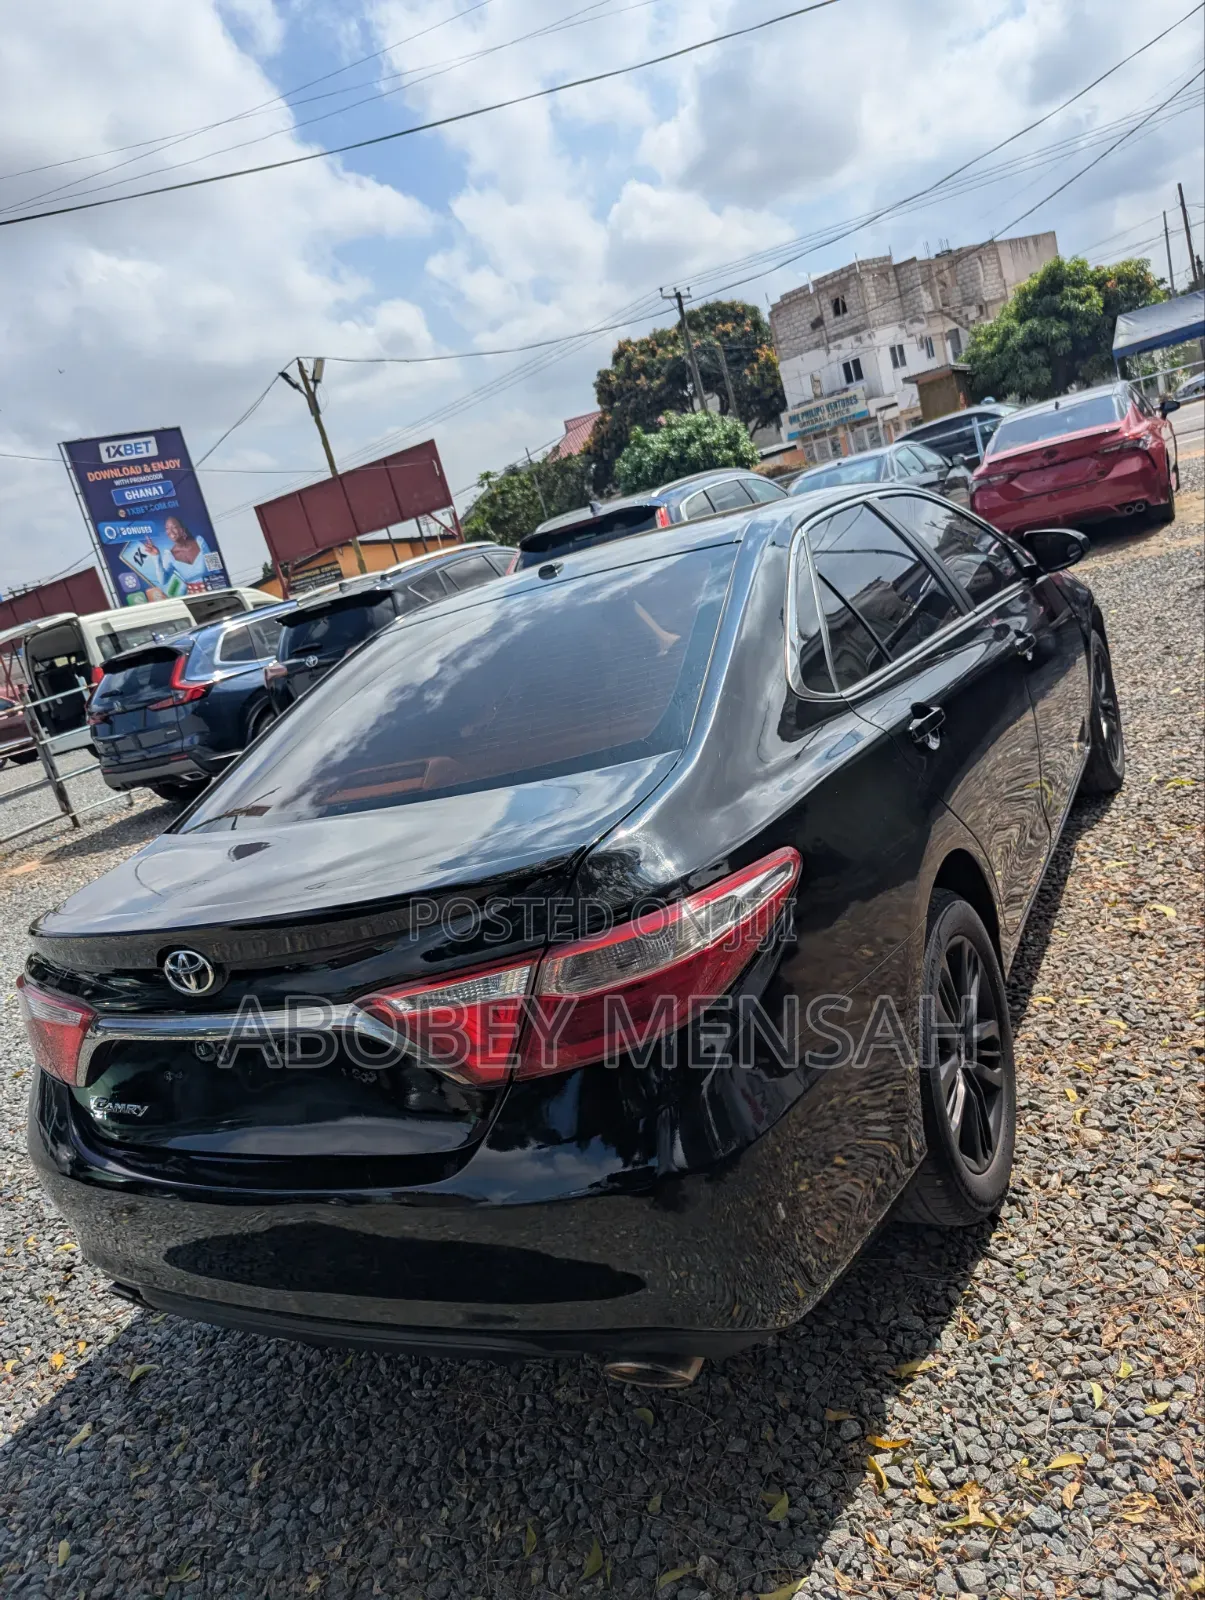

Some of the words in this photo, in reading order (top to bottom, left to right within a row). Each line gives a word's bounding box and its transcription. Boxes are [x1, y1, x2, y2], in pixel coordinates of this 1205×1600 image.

[827, 408, 851, 420] OFFICE
[105, 440, 152, 459] 1XBET
[87, 464, 142, 482] DOWNLOAD
[143, 464, 151, 473] &
[151, 459, 181, 473] ENJOY
[114, 476, 130, 486] WITH
[130, 473, 164, 484] PROMOCODE
[124, 485, 165, 501] GHANA1
[120, 525, 153, 537] BONUSES
[93, 1096, 149, 1118] CAMRY
